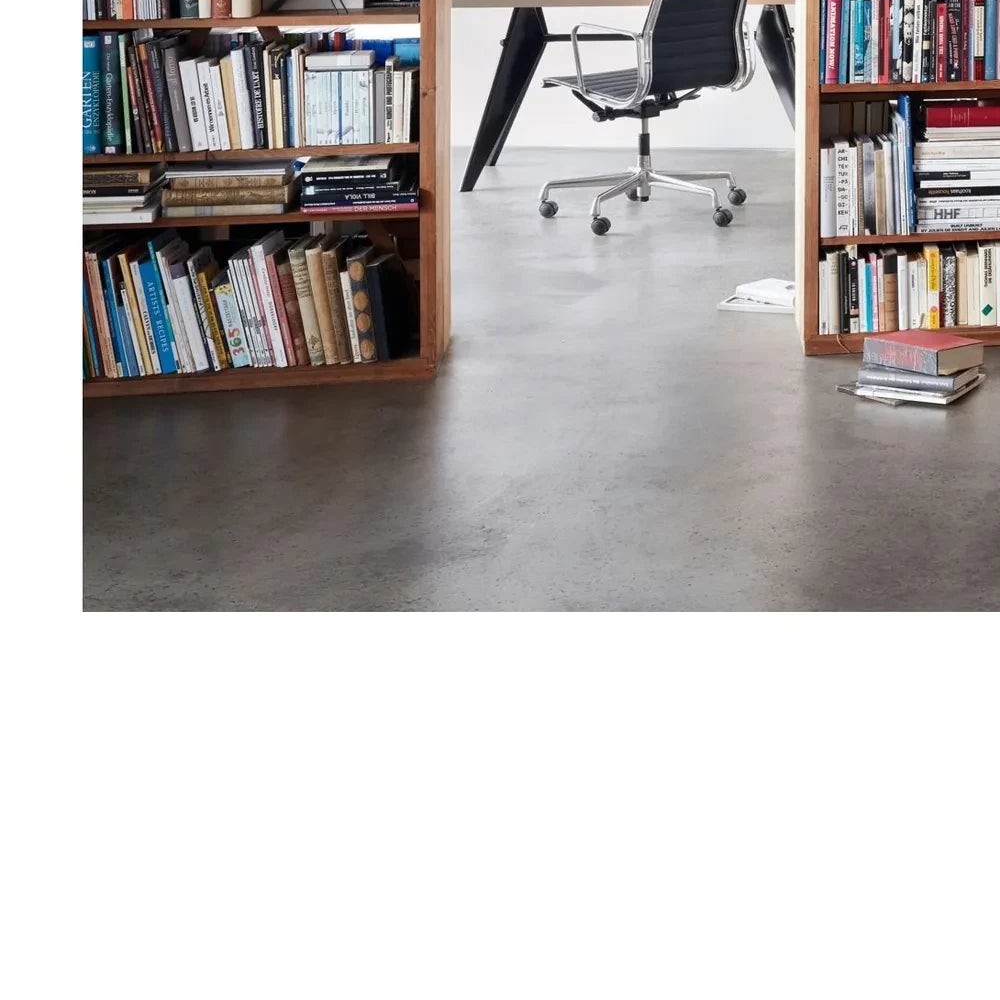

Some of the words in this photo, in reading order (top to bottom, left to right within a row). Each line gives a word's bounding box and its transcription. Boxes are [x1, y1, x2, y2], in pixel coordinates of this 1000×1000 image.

[83, 72, 92, 128] GARTEN
[104, 73, 114, 142] Garten-Enzyklopädie
[254, 90, 261, 98] DE
[256, 99, 264, 129] HISTOIRE
[934, 209, 960, 219] HHF
[156, 320, 168, 352] RECIPES
[227, 328, 244, 356] 365
